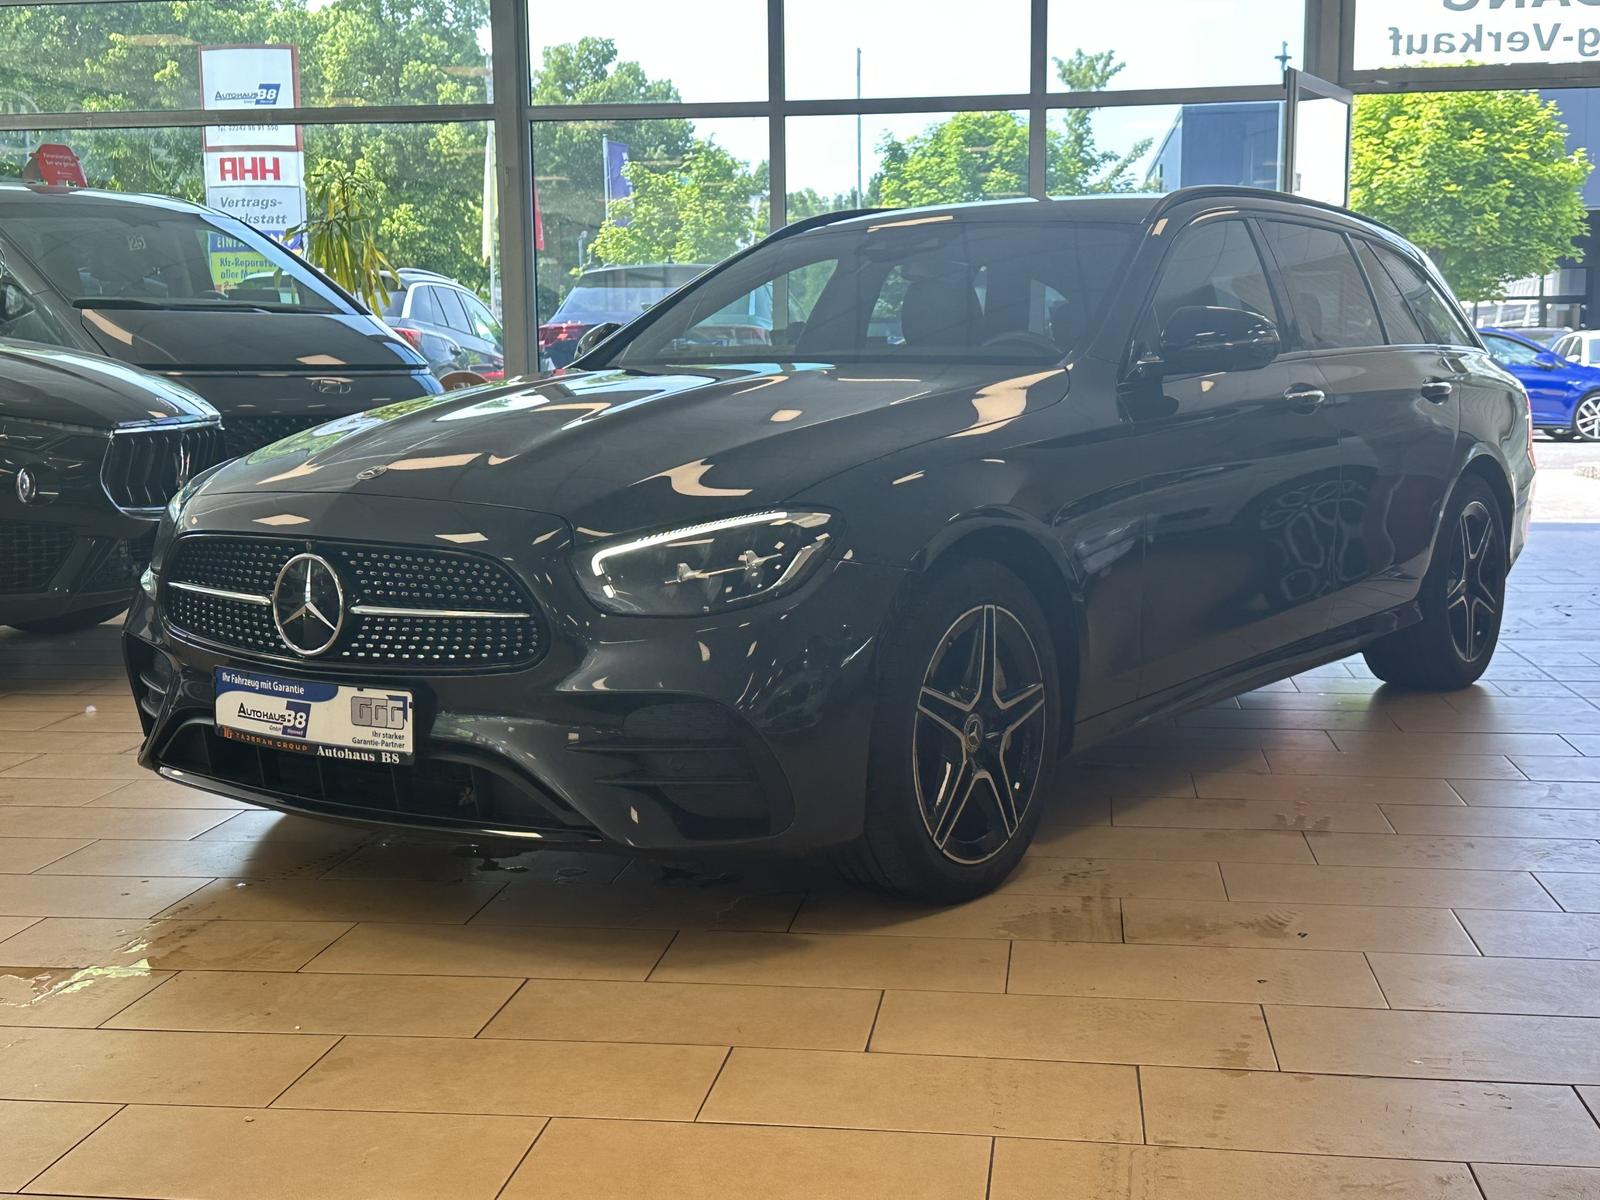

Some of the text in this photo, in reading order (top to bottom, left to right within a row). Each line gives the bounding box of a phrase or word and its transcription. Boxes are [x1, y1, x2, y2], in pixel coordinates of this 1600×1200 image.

[219, 157, 281, 181] AHH
[220, 197, 283, 209] Vertrags-
[239, 213, 287, 224] rkstatt
[231, 674, 260, 690] Fahrzeug
[260, 680, 272, 690] mit
[273, 681, 305, 695] Garantie
[238, 702, 287, 722] AUTOHAUS
[352, 737, 405, 749] Garantie-Partner
[372, 730, 405, 741] Ihr starker
[317, 745, 400, 764] Autohaus B8
